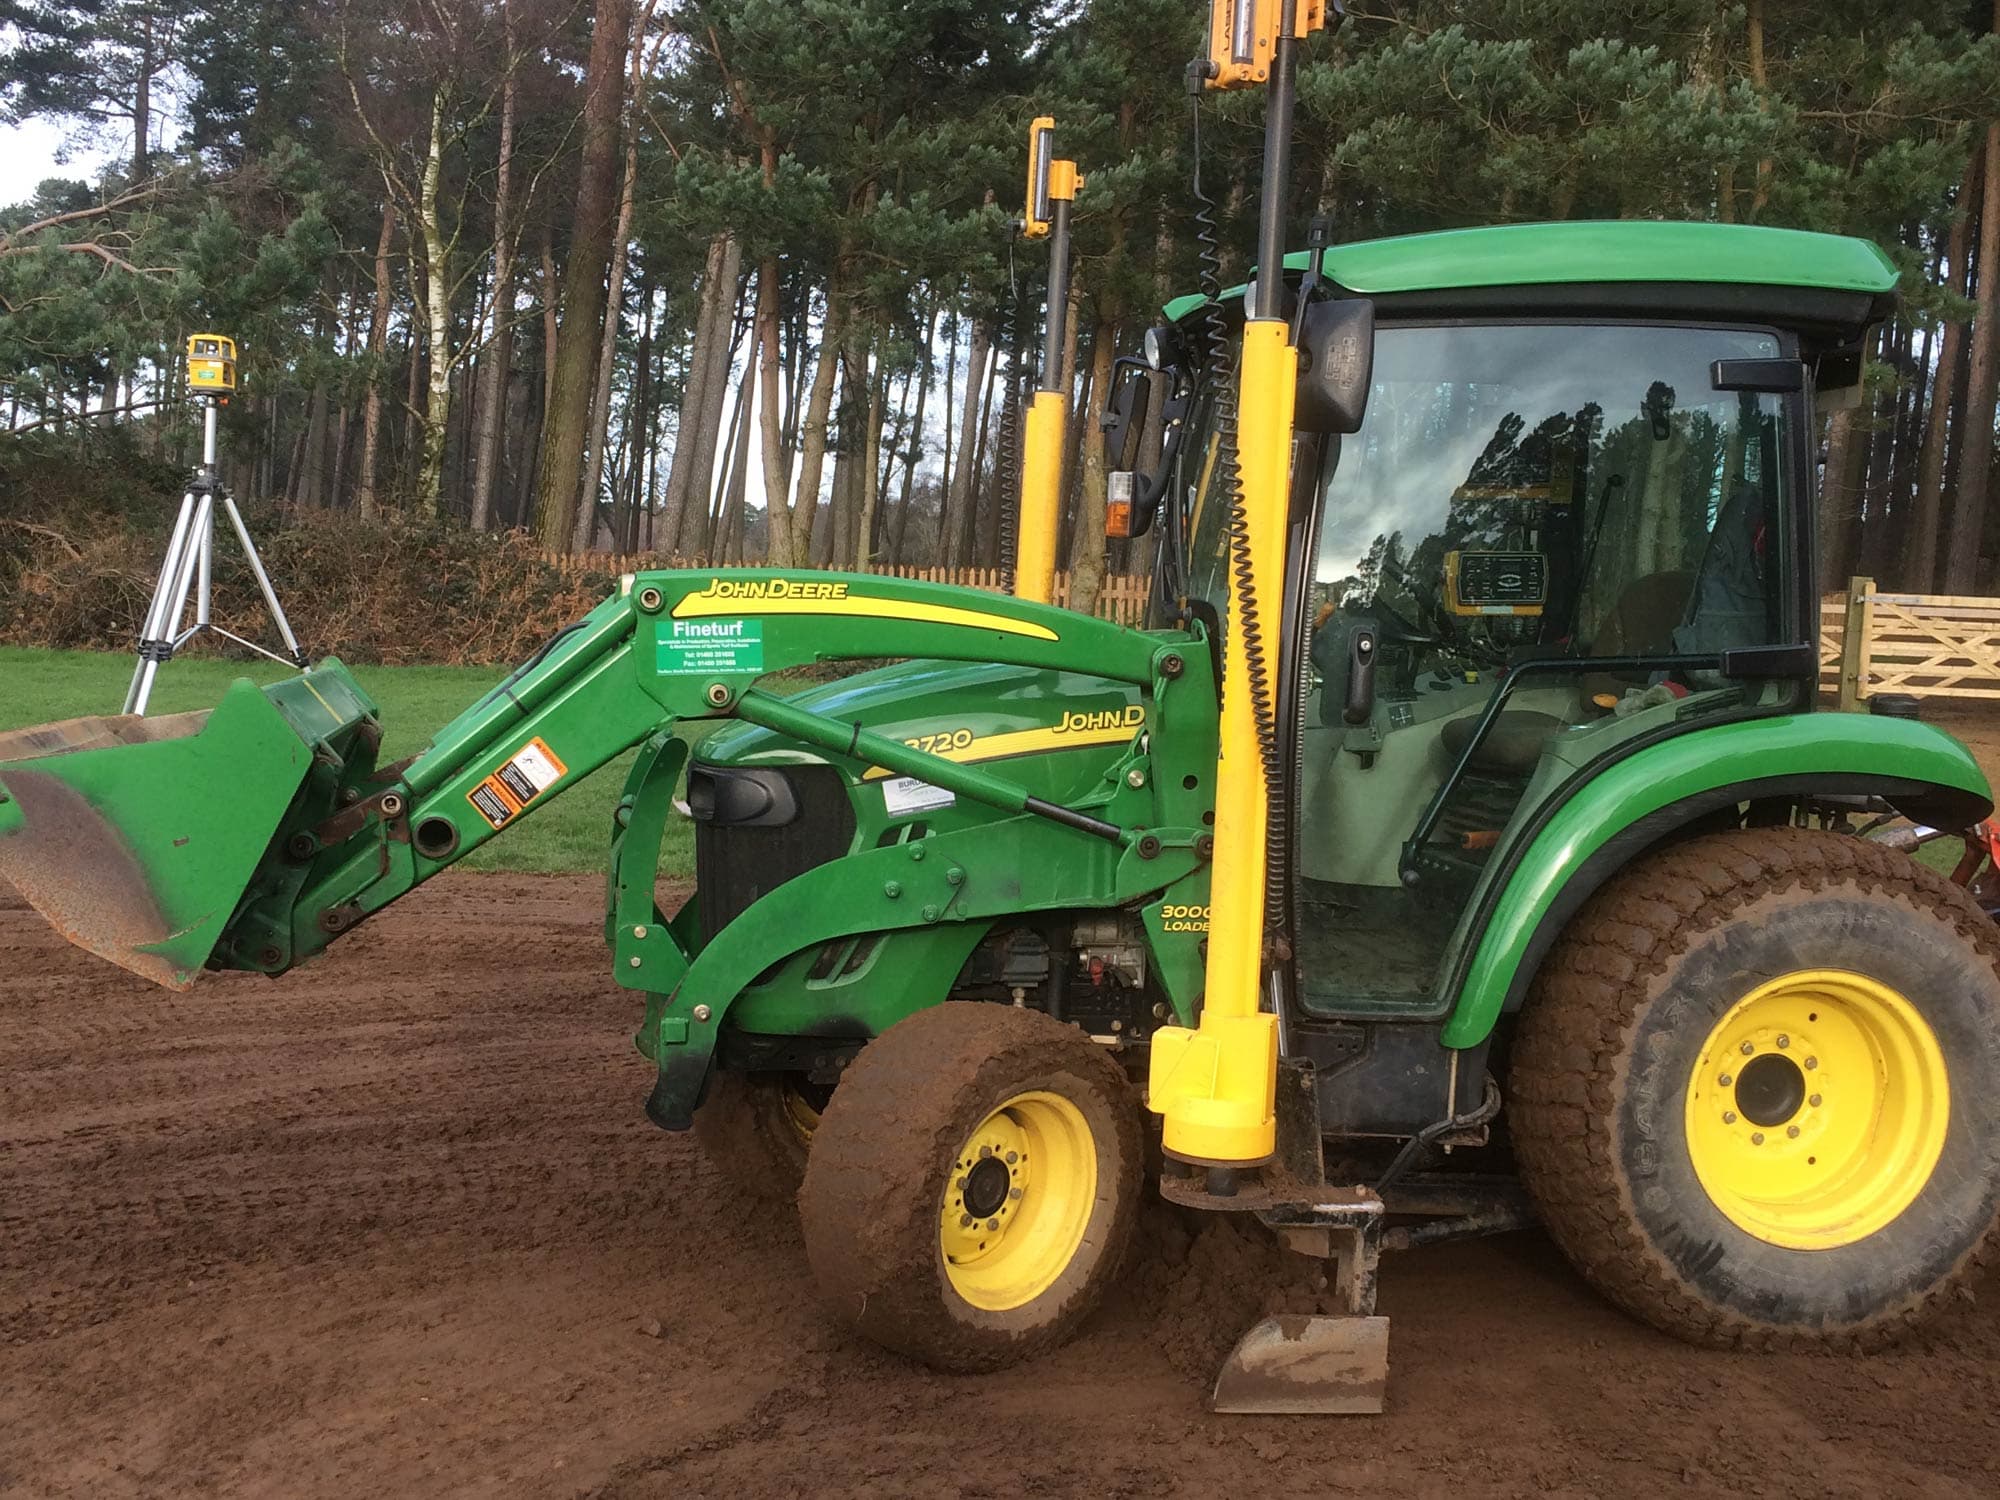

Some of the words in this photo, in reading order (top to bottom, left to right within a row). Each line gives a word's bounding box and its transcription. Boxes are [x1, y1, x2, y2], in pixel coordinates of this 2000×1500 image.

[700, 577, 766, 598] JOHN
[766, 578, 849, 599] DEERE
[673, 620, 743, 637] Fineturf
[1052, 711, 1121, 732] JOHN
[1163, 921, 1210, 932] LOADE
